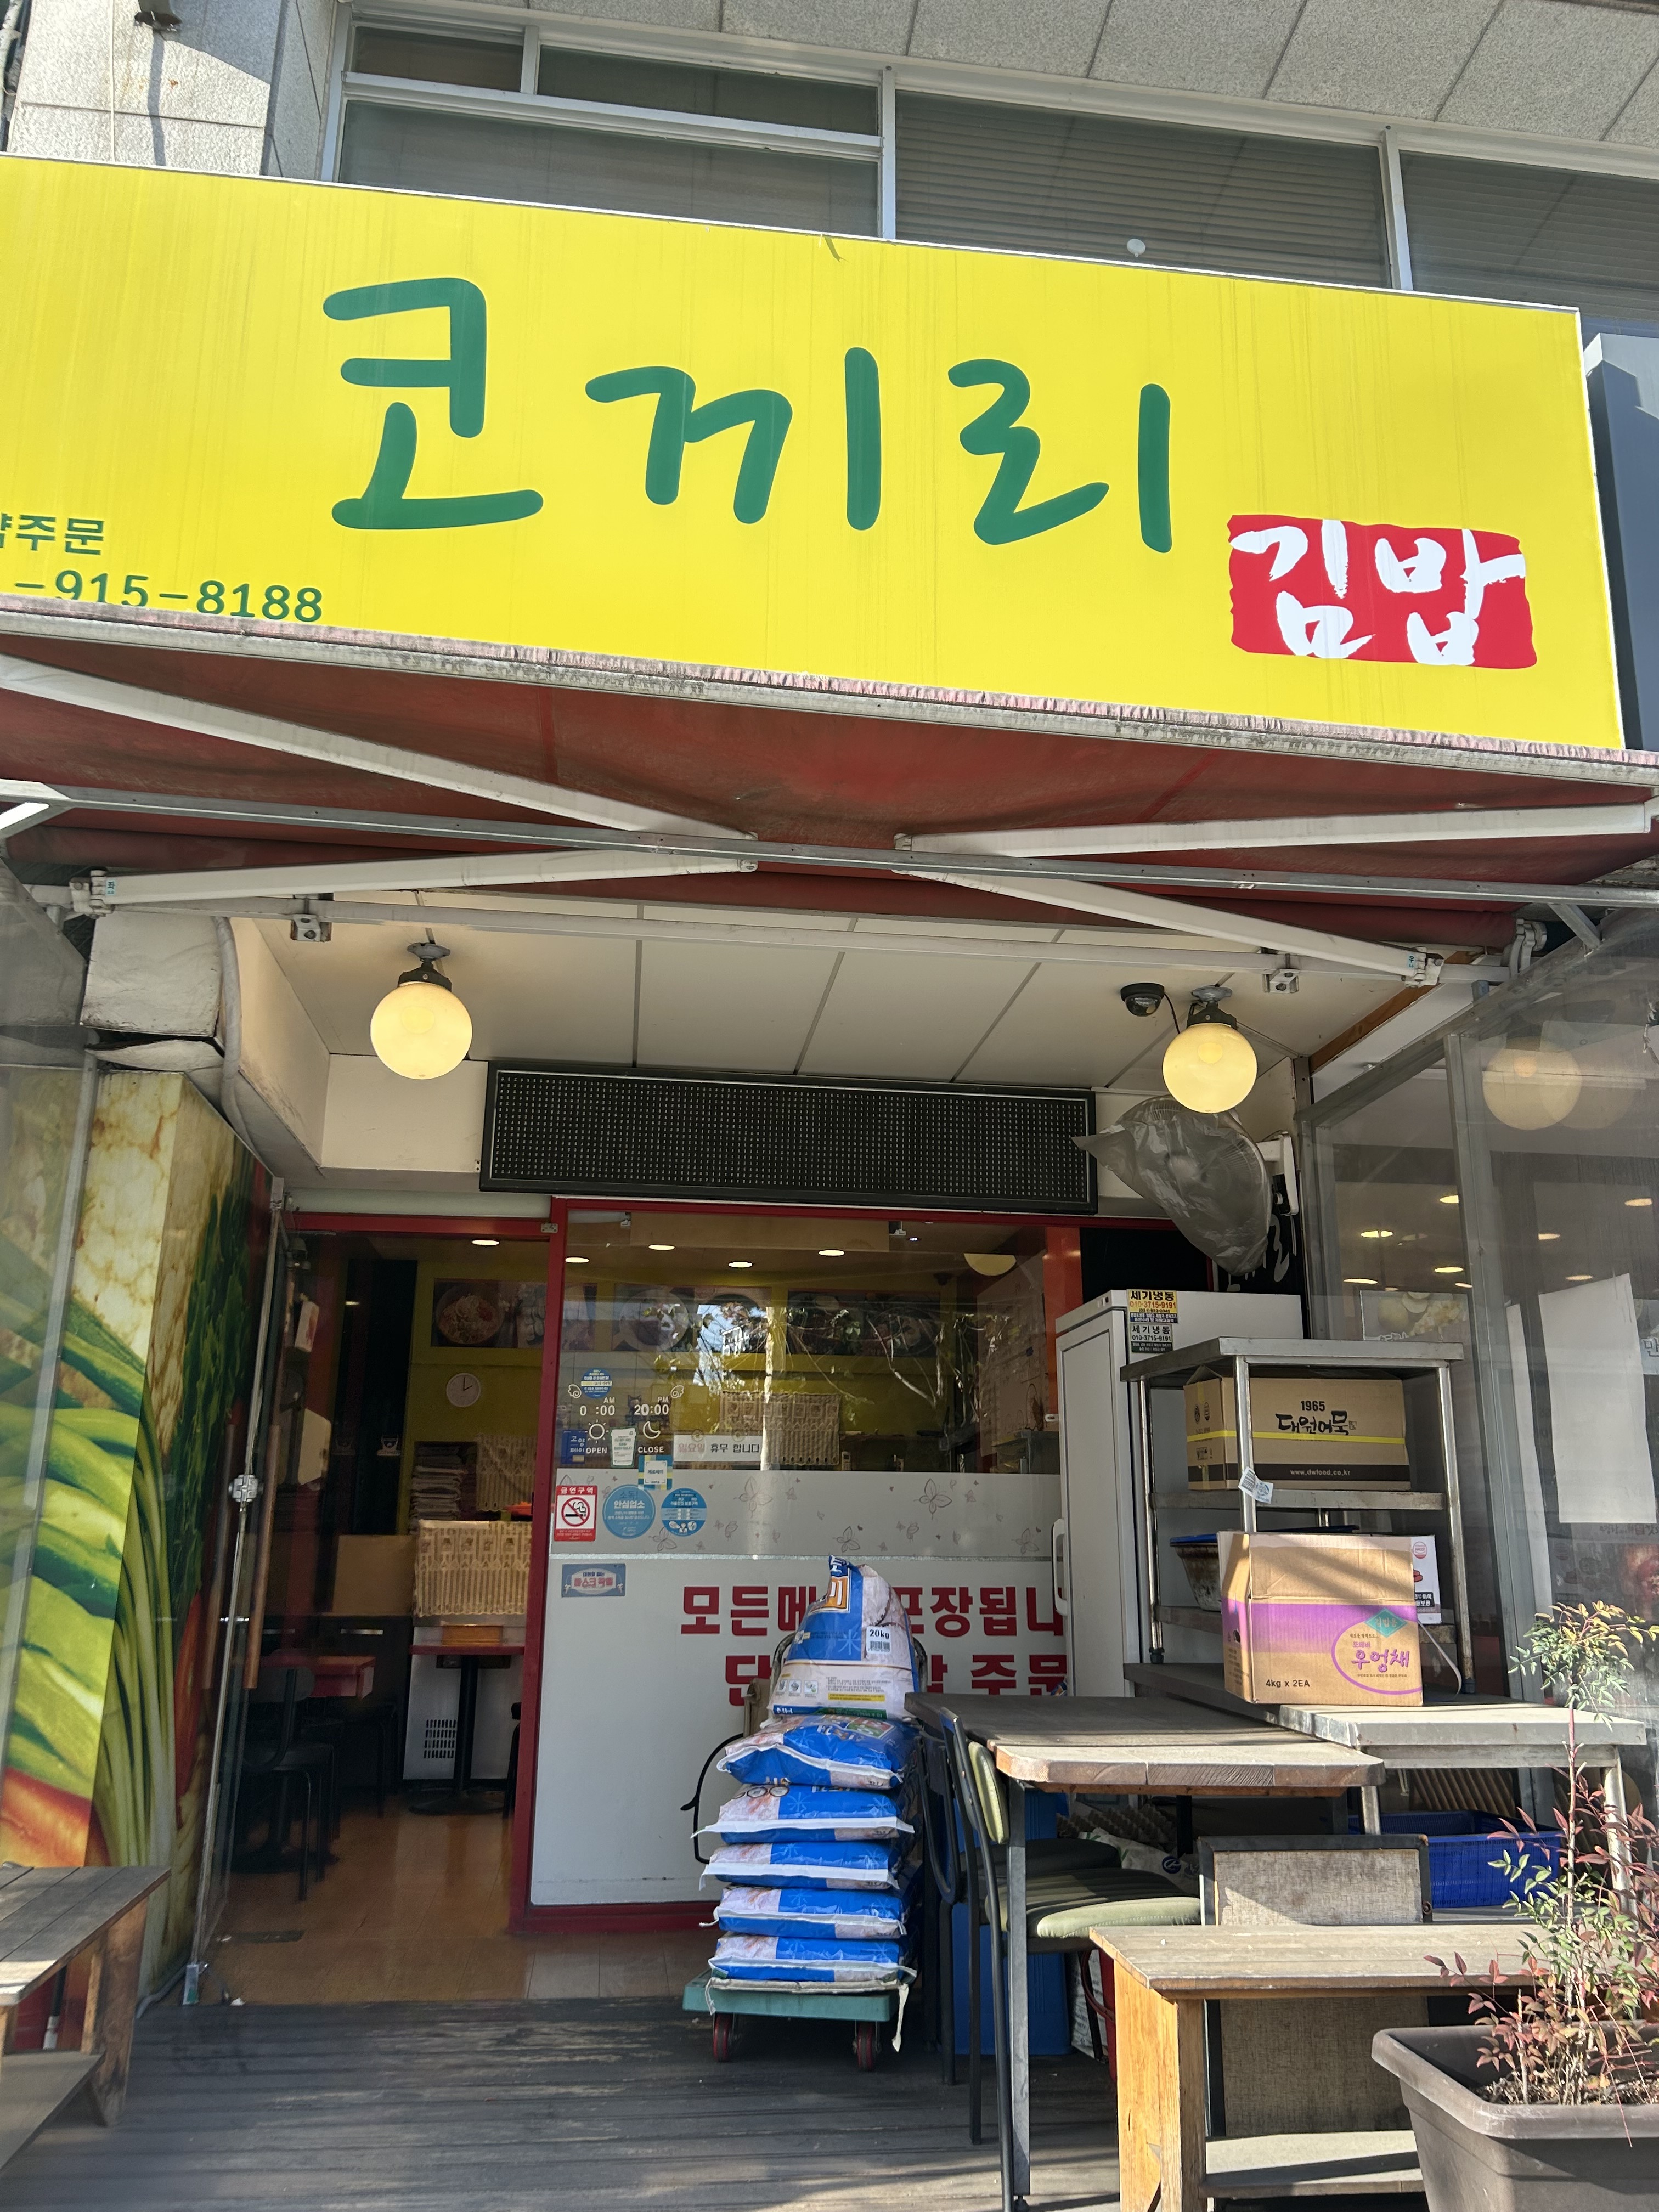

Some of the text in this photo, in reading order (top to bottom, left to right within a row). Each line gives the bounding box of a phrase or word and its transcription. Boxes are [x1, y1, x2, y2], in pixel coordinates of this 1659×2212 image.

[323, 277, 1172, 553] 코끼리
[1229, 518, 1526, 666] 김밥
[1130, 1290, 1175, 1301] 세기냉동
[1130, 1300, 1176, 1309] 010-3715-9191
[1132, 1324, 1170, 1334] 세기냉동
[634, 1403, 669, 1416] 20:00
[1301, 1400, 1325, 1412] 1965
[1275, 1410, 1350, 1436] 대원어묵
[678, 1443, 760, 1453] 일요일 휴무 합니다
[614, 1500, 645, 1509] 안심업소
[681, 1585, 817, 1636] 모든메
[891, 1586, 1064, 1637] 포장됩니
[870, 1629, 889, 1639] 20kg
[1351, 1649, 1410, 1673] 우엉채
[1266, 1679, 1282, 1688] 4kg
[1293, 1679, 1311, 1688] 2EA
